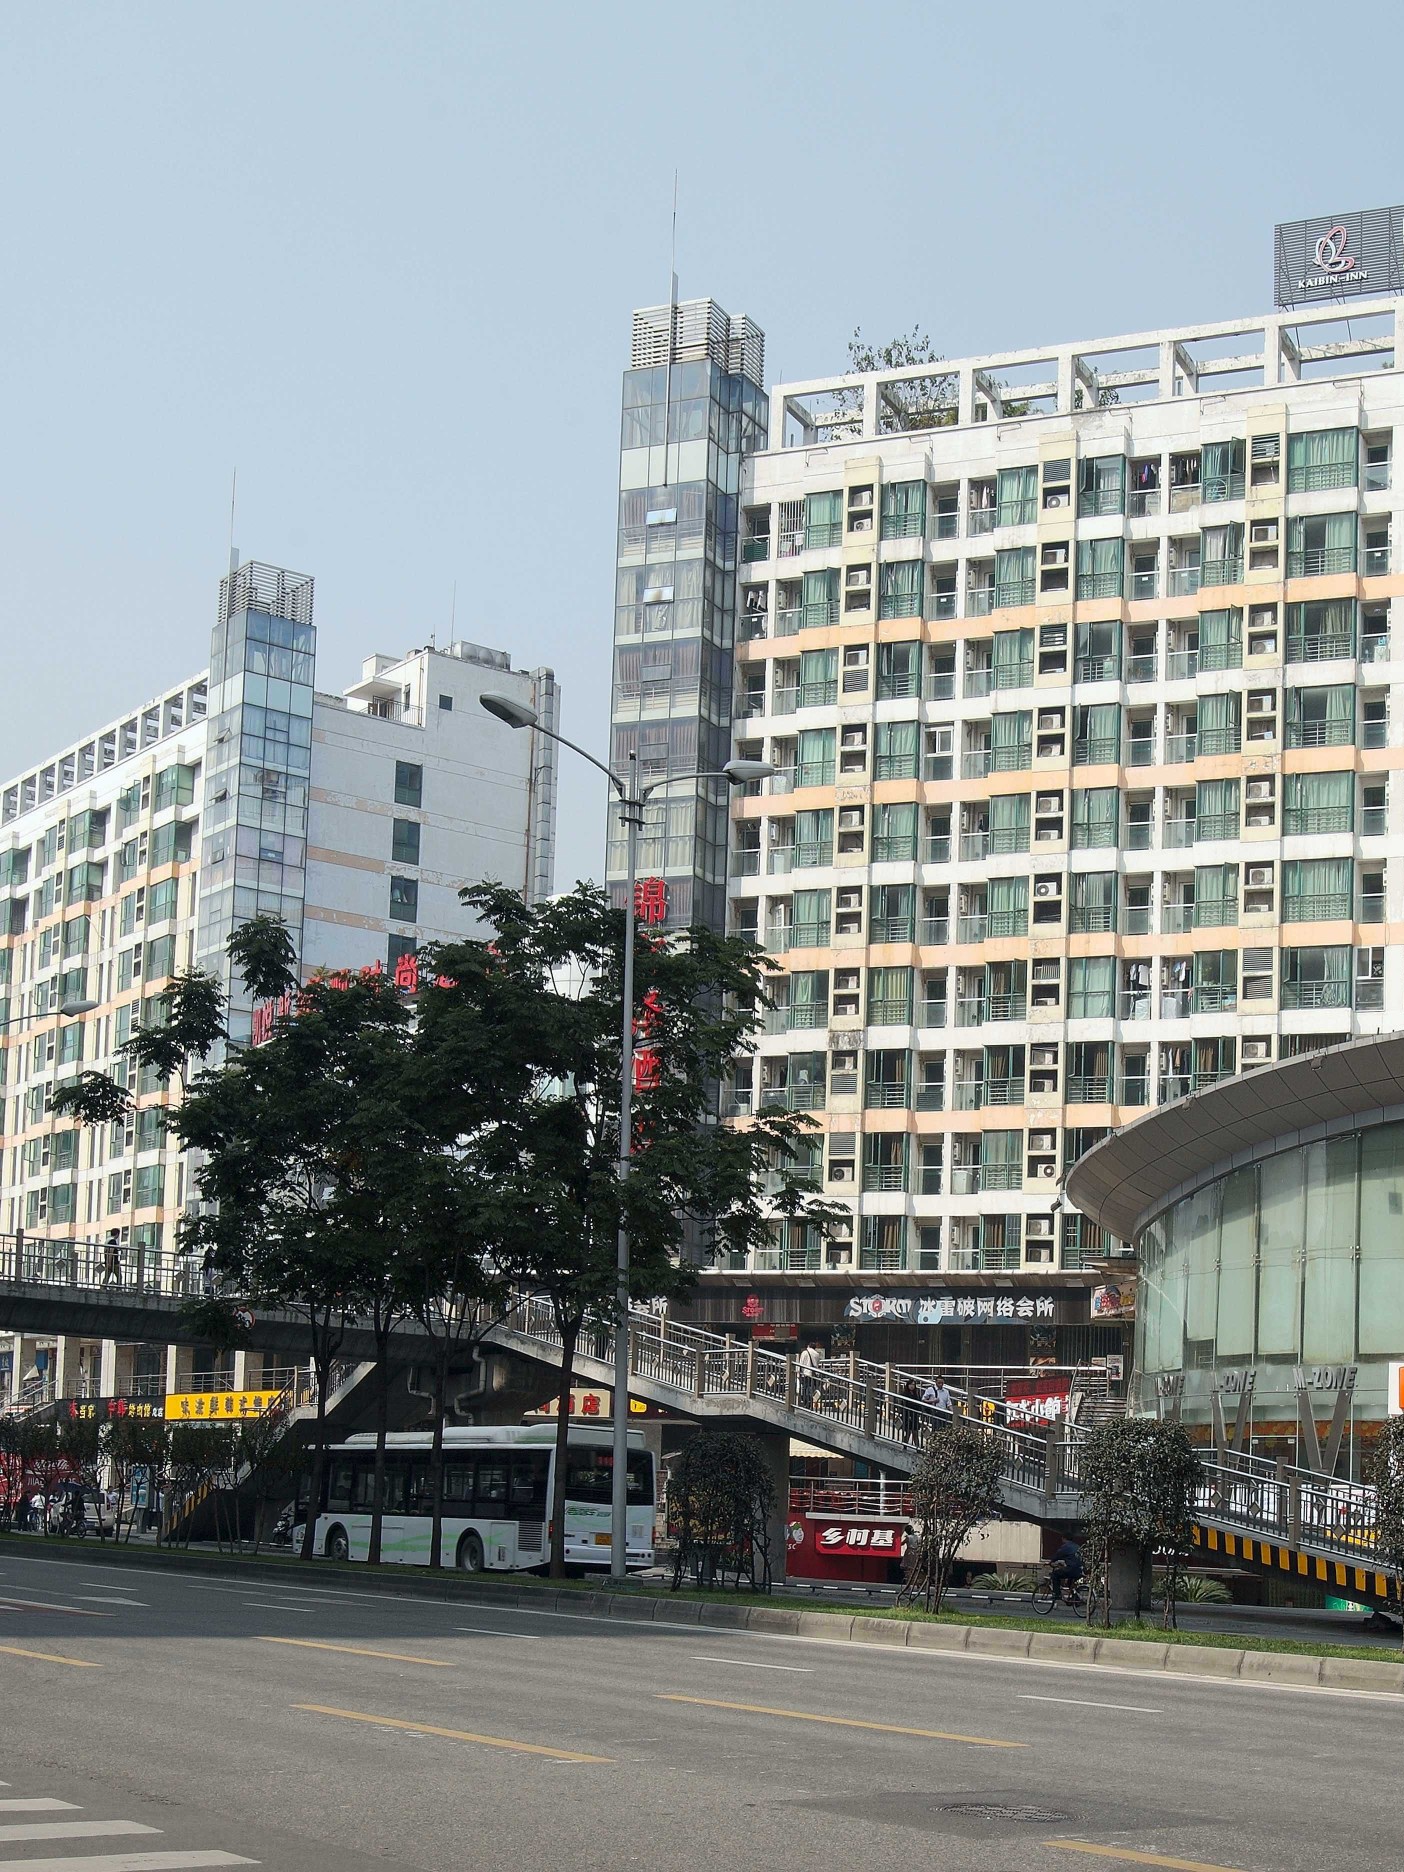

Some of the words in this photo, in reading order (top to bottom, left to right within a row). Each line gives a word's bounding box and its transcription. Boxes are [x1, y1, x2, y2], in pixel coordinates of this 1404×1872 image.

[1298, 271, 1368, 289] KAIBIN-INN
[1293, 1367, 1358, 1390] M-ZONE
[820, 1527, 895, 1547] 乡村基
